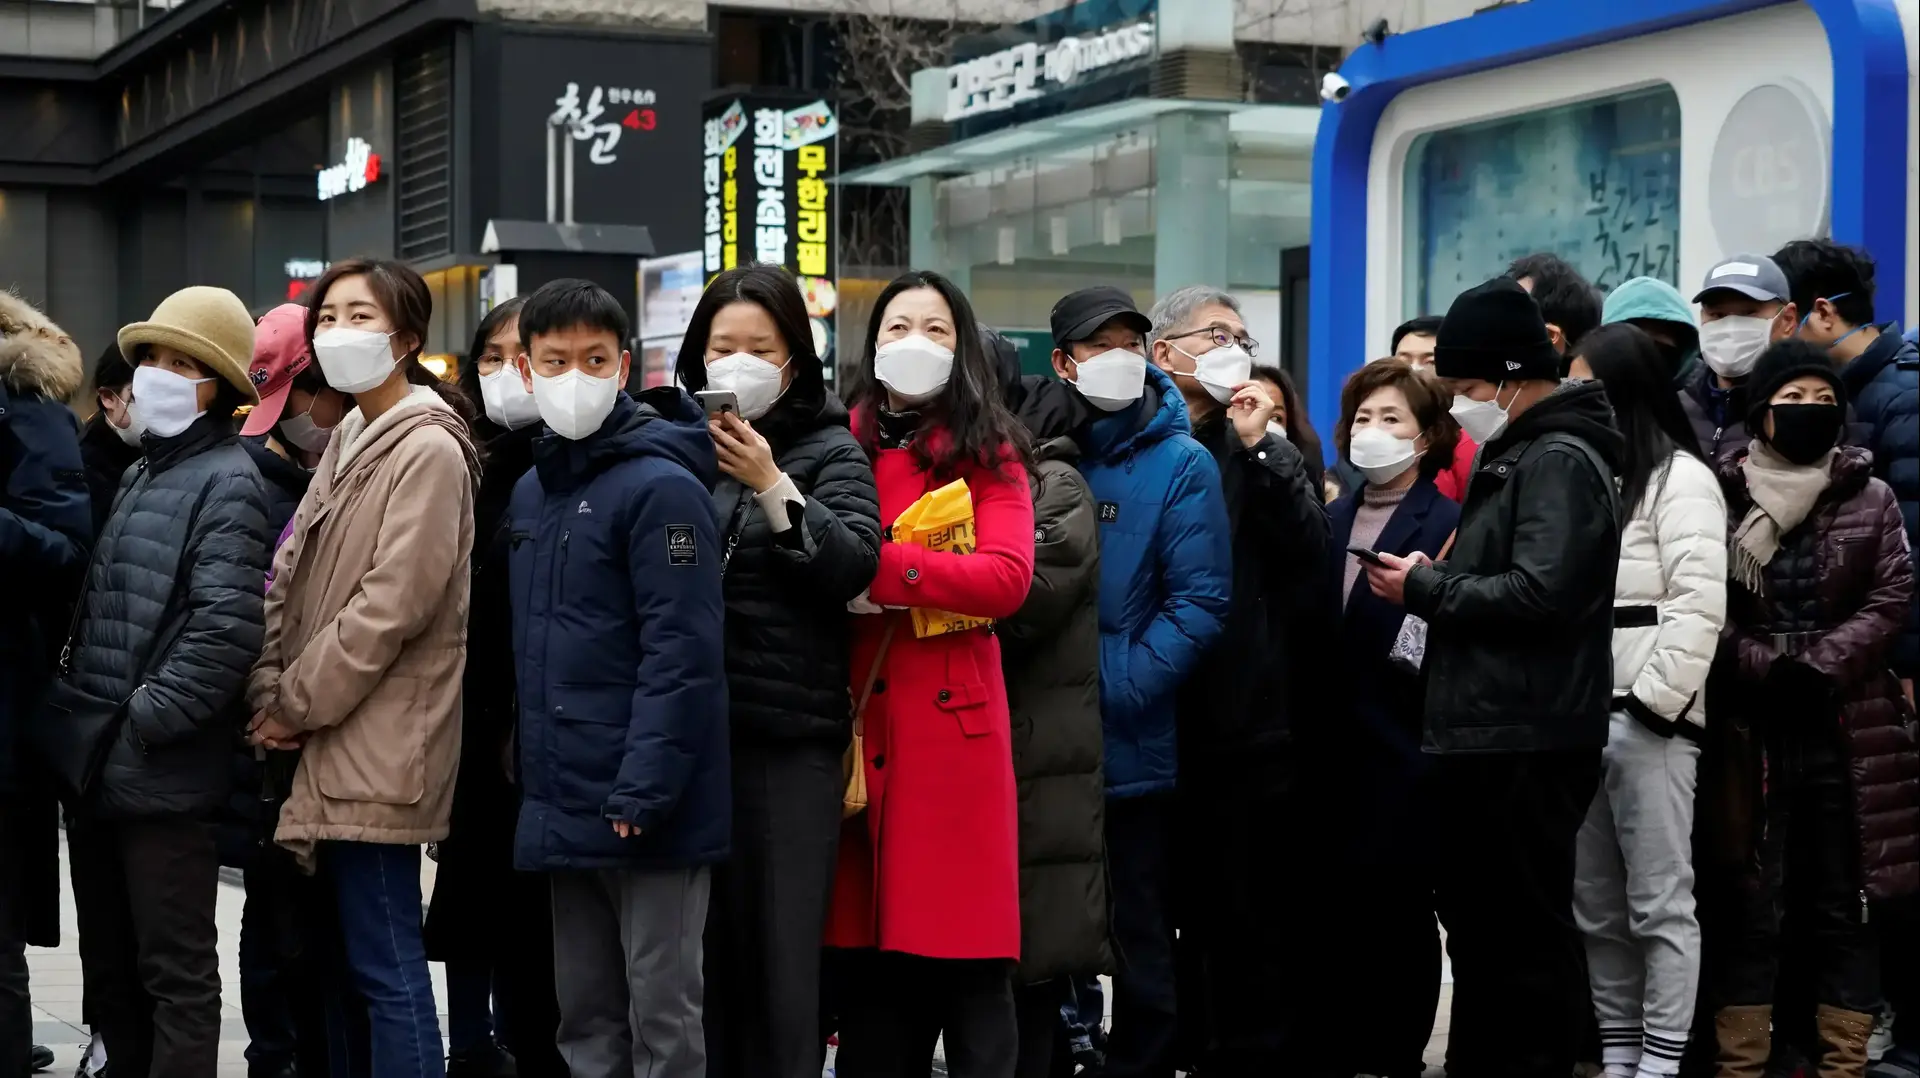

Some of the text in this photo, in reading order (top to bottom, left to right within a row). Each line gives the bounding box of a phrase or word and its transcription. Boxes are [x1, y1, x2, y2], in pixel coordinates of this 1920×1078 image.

[623, 109, 656, 131] 43
[754, 107, 788, 265] 회전초밥
[797, 145, 828, 276] 무한리필
[928, 523, 967, 547] LIFE!
